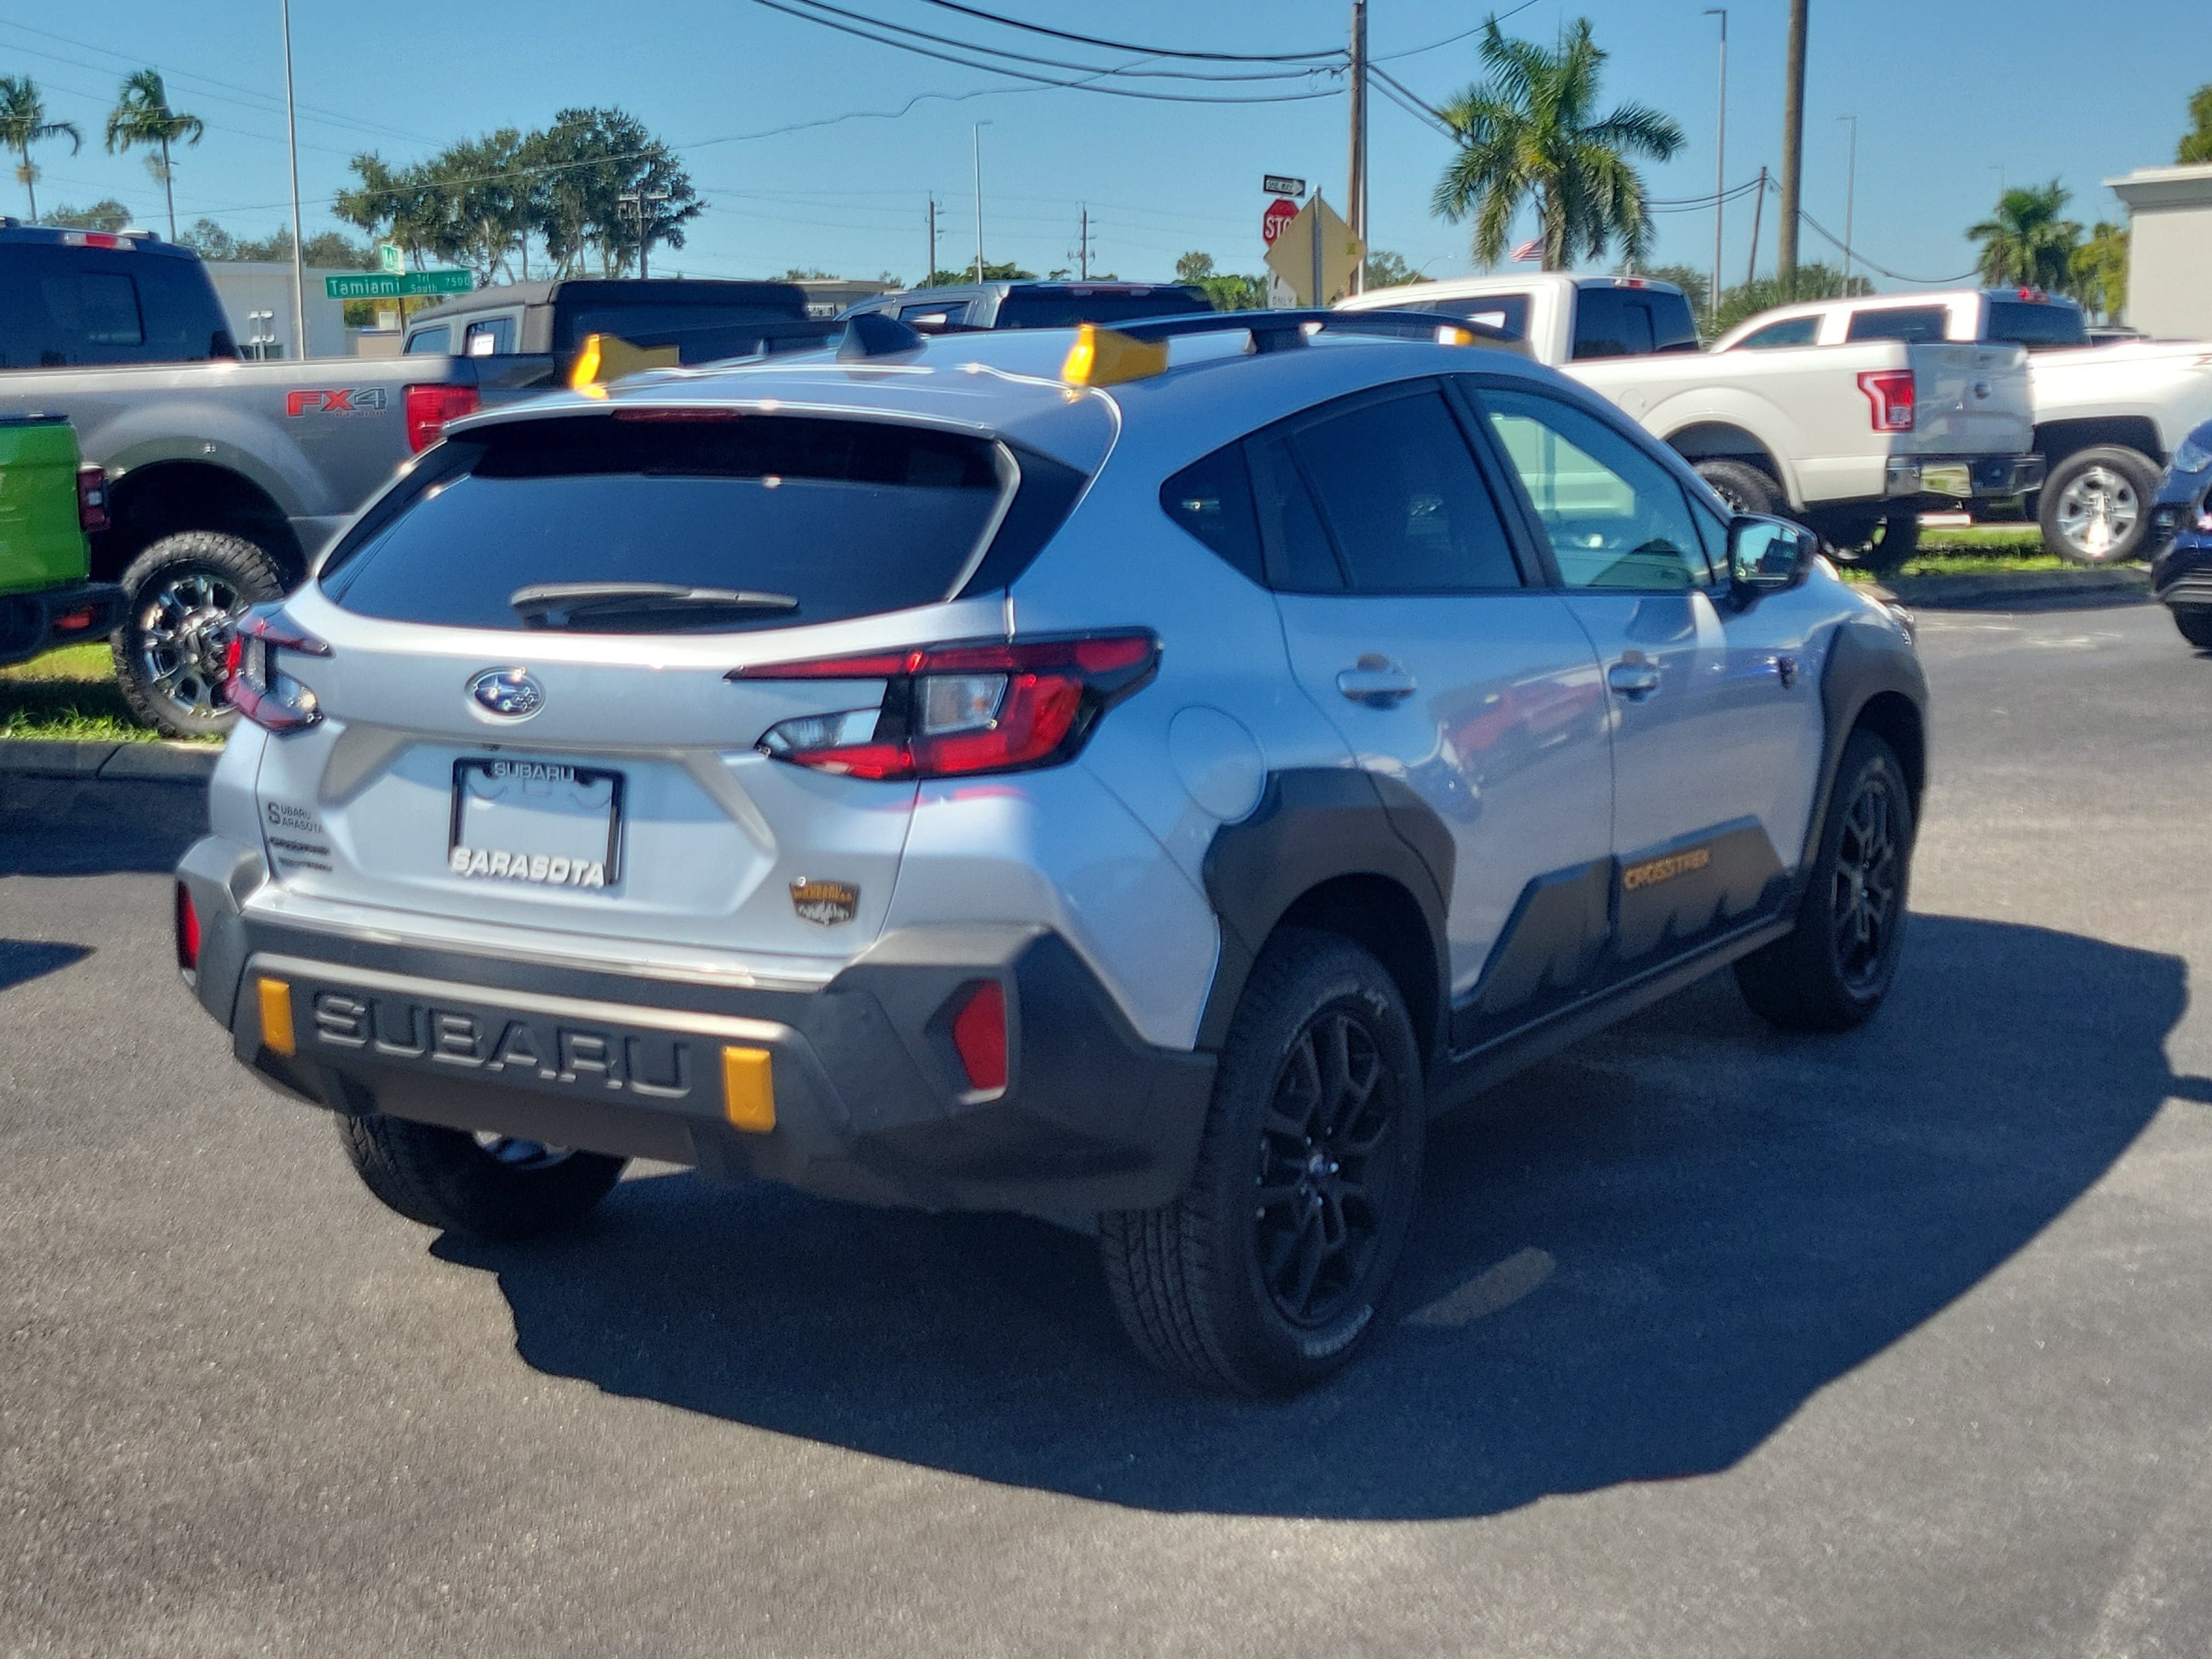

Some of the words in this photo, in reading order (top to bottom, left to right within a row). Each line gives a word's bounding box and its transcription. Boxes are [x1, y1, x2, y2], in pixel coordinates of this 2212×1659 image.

[330, 278, 400, 295] Tamiami
[411, 284, 437, 293] South
[286, 387, 387, 418] FX4
[494, 761, 575, 782] SUBARU
[451, 847, 605, 889] SARASOTA
[314, 991, 692, 1098] SUBARU
